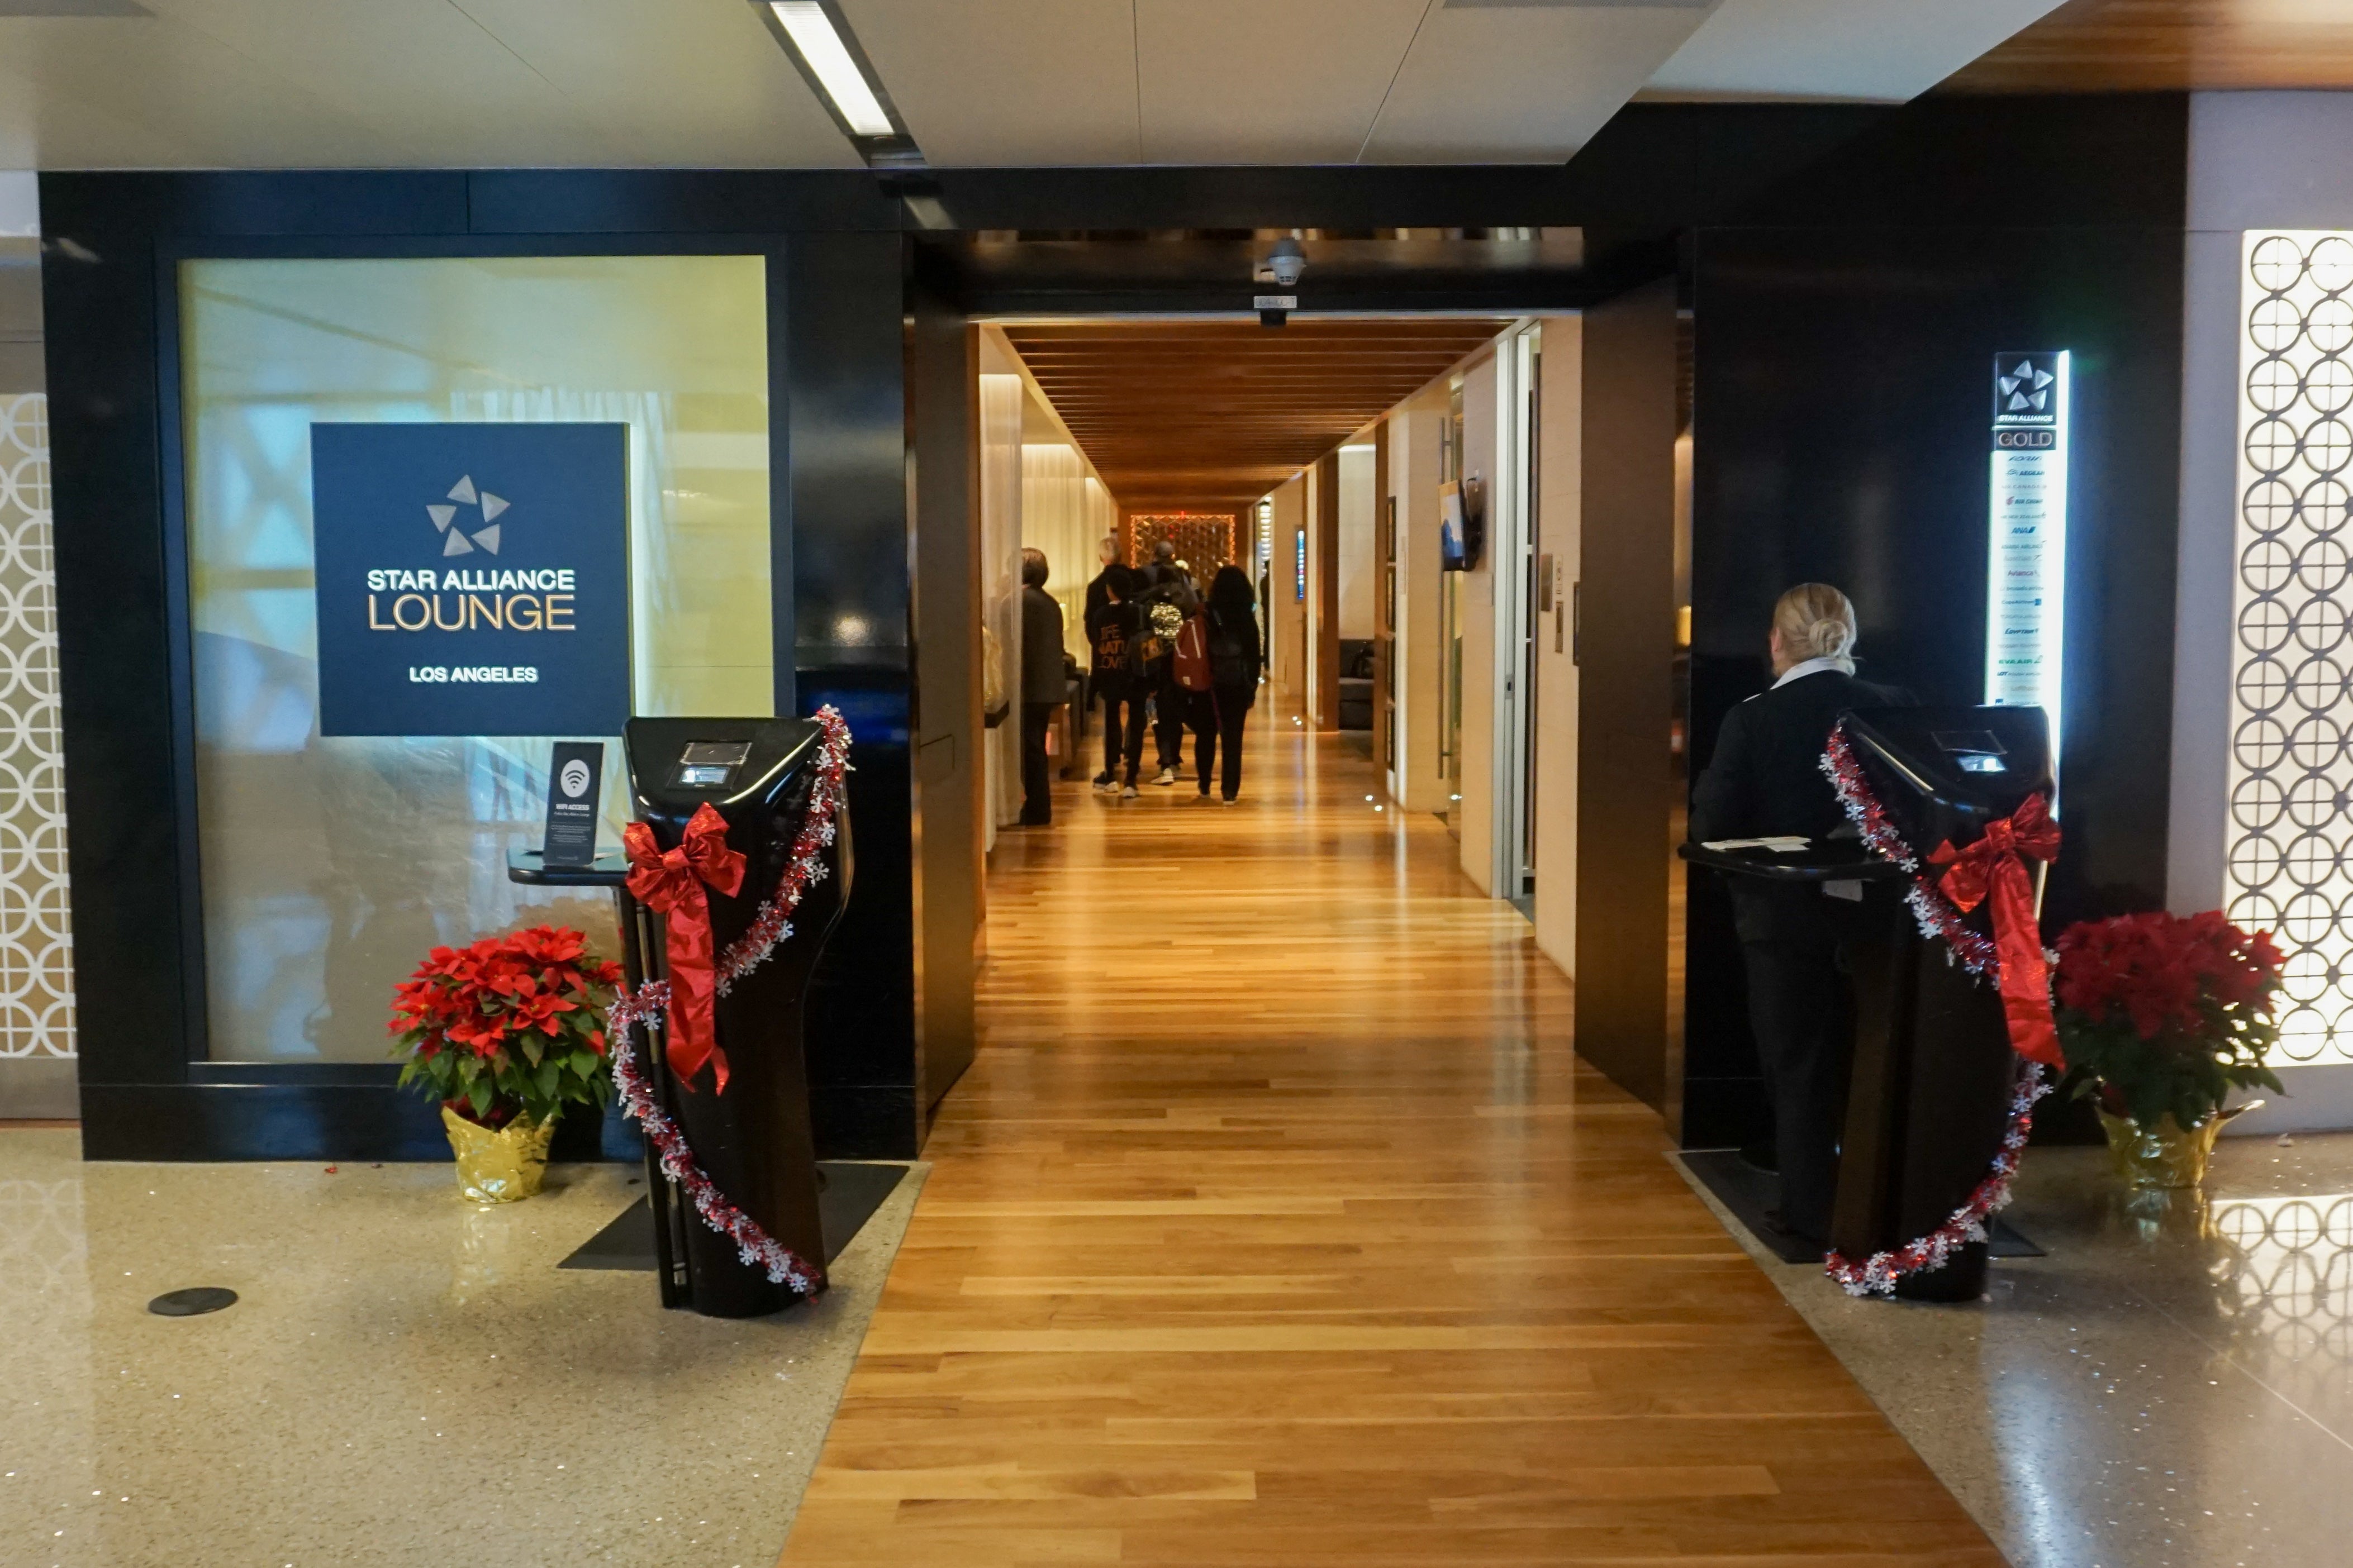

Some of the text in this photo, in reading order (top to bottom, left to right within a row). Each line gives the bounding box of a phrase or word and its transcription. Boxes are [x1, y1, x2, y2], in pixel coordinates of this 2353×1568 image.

[1998, 432, 2052, 447] GOLD
[367, 569, 576, 591] STAR ALLIANCE
[368, 594, 576, 631] LOUNGE
[409, 666, 539, 683] LOS ANGELES
